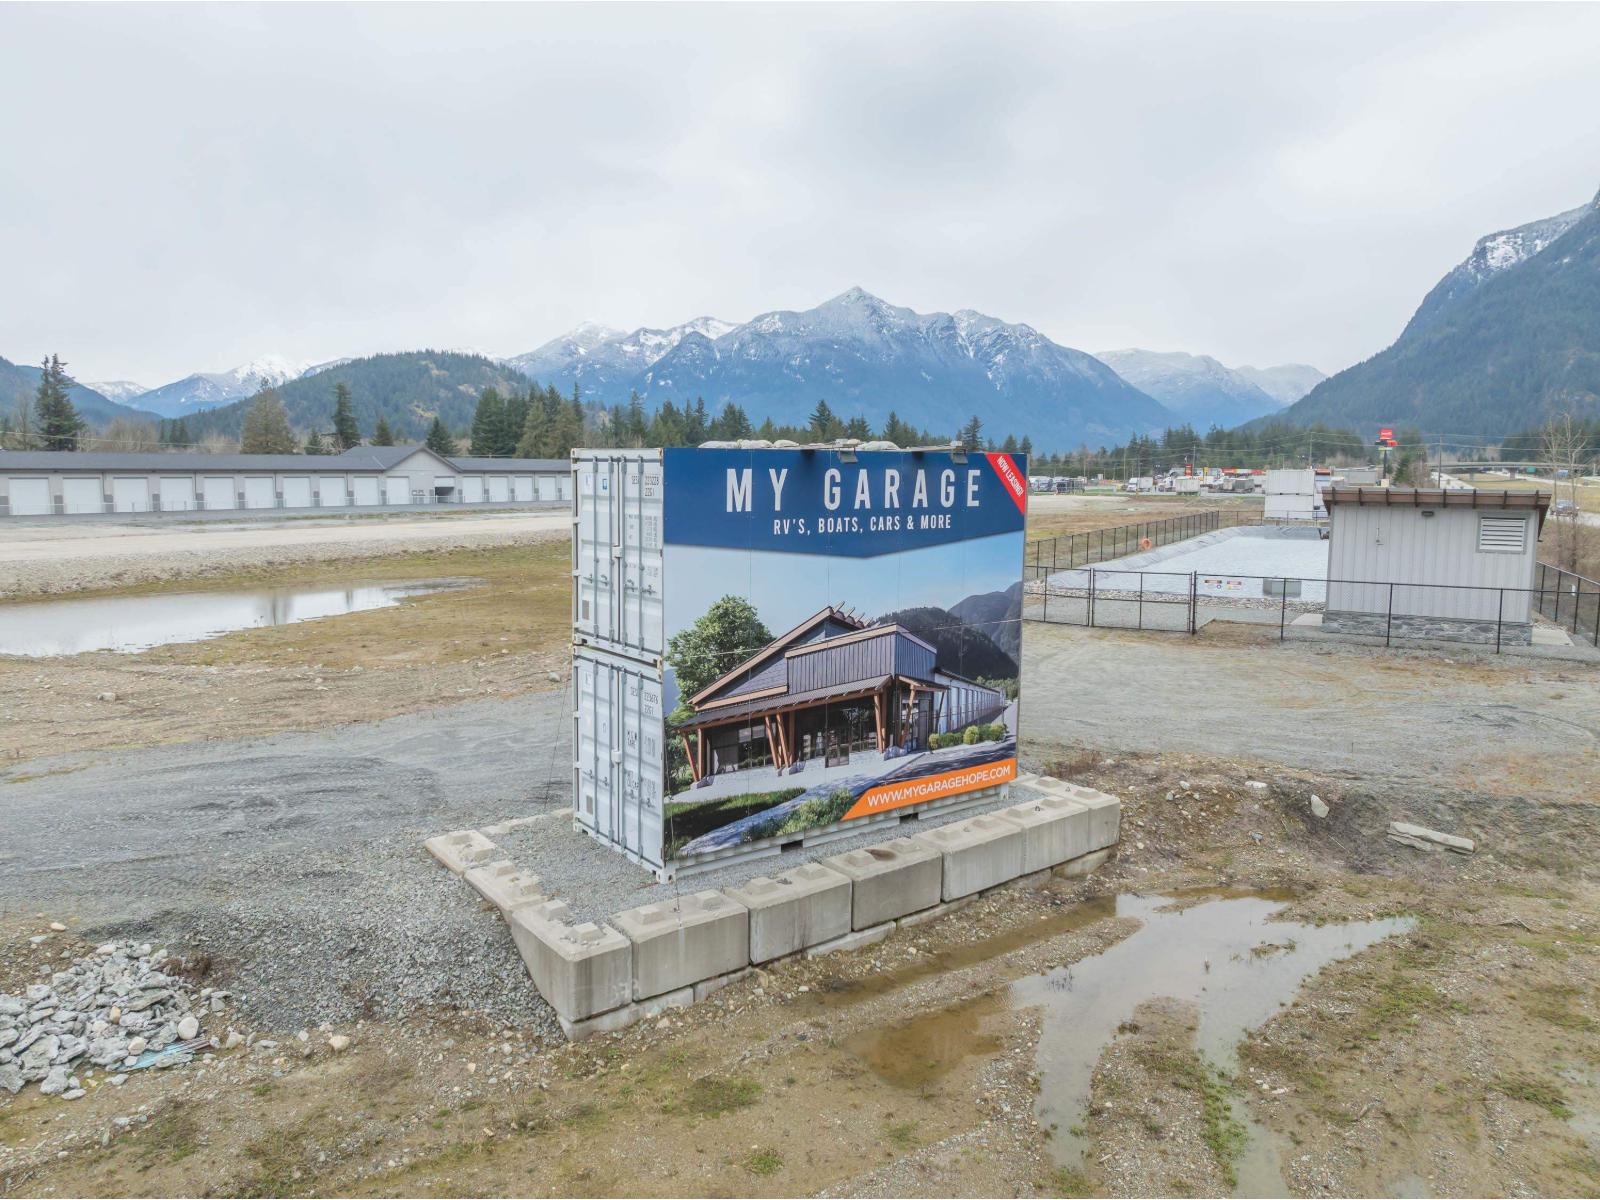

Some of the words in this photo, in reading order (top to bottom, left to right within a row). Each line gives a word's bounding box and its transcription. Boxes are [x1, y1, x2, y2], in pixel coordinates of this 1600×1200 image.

[997, 455, 1009, 472] NOW
[726, 468, 788, 512] MY
[824, 468, 981, 510] GARAGE
[773, 518, 811, 535] RV'S,
[818, 517, 863, 533] BOATS,
[870, 516, 900, 531] CARS
[906, 516, 915, 530] &
[920, 514, 951, 529] MORE
[867, 764, 1011, 807] WWW.MYGARAGEHOPE.COM
